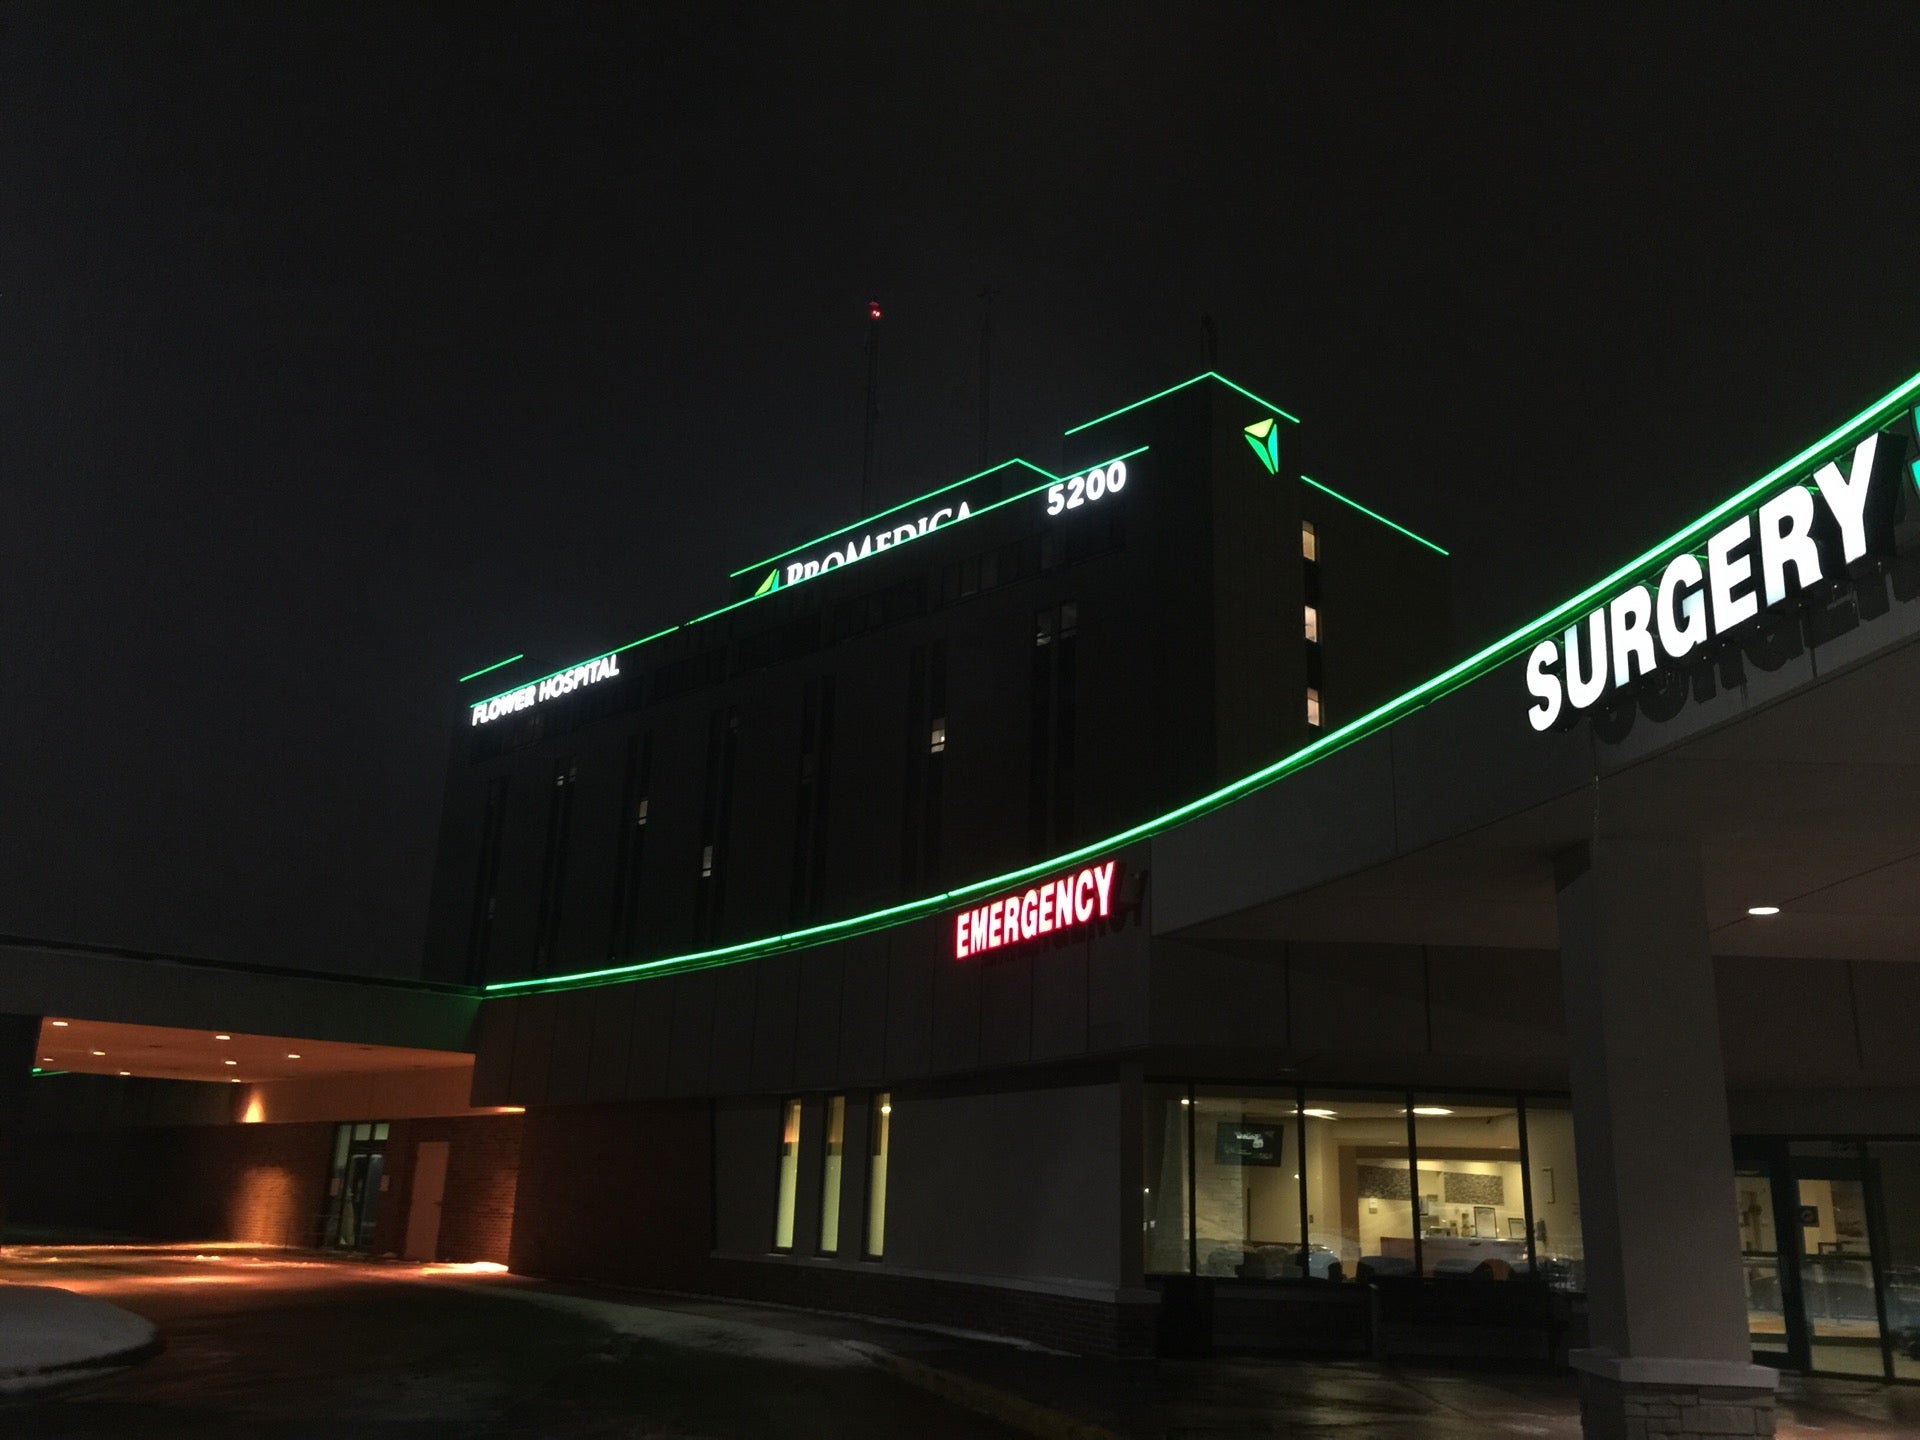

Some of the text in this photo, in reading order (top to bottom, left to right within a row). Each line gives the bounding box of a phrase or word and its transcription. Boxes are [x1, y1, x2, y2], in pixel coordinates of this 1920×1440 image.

[1047, 460, 1127, 516] 5200
[1526, 432, 1879, 732] SURGERY
[471, 653, 620, 727] FLOWER HOSPITAL
[956, 860, 1116, 960] EMERGENCY
